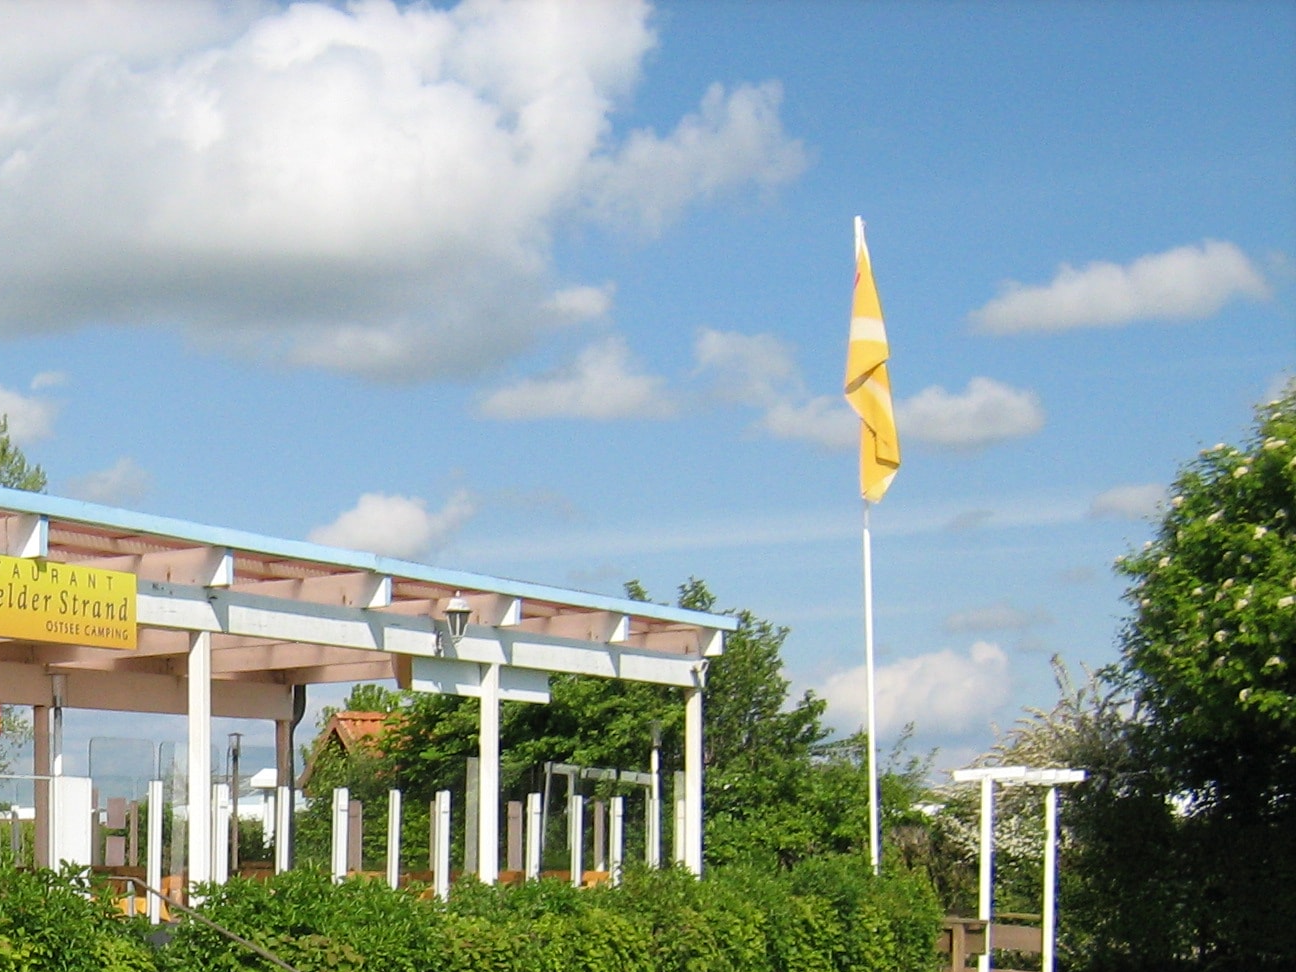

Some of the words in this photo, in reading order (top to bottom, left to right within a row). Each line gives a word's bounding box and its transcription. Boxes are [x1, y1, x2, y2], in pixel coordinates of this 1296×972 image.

[59, 590, 129, 622] Strand
[45, 620, 80, 635] OSTSEE
[84, 625, 129, 641] CAMPING
